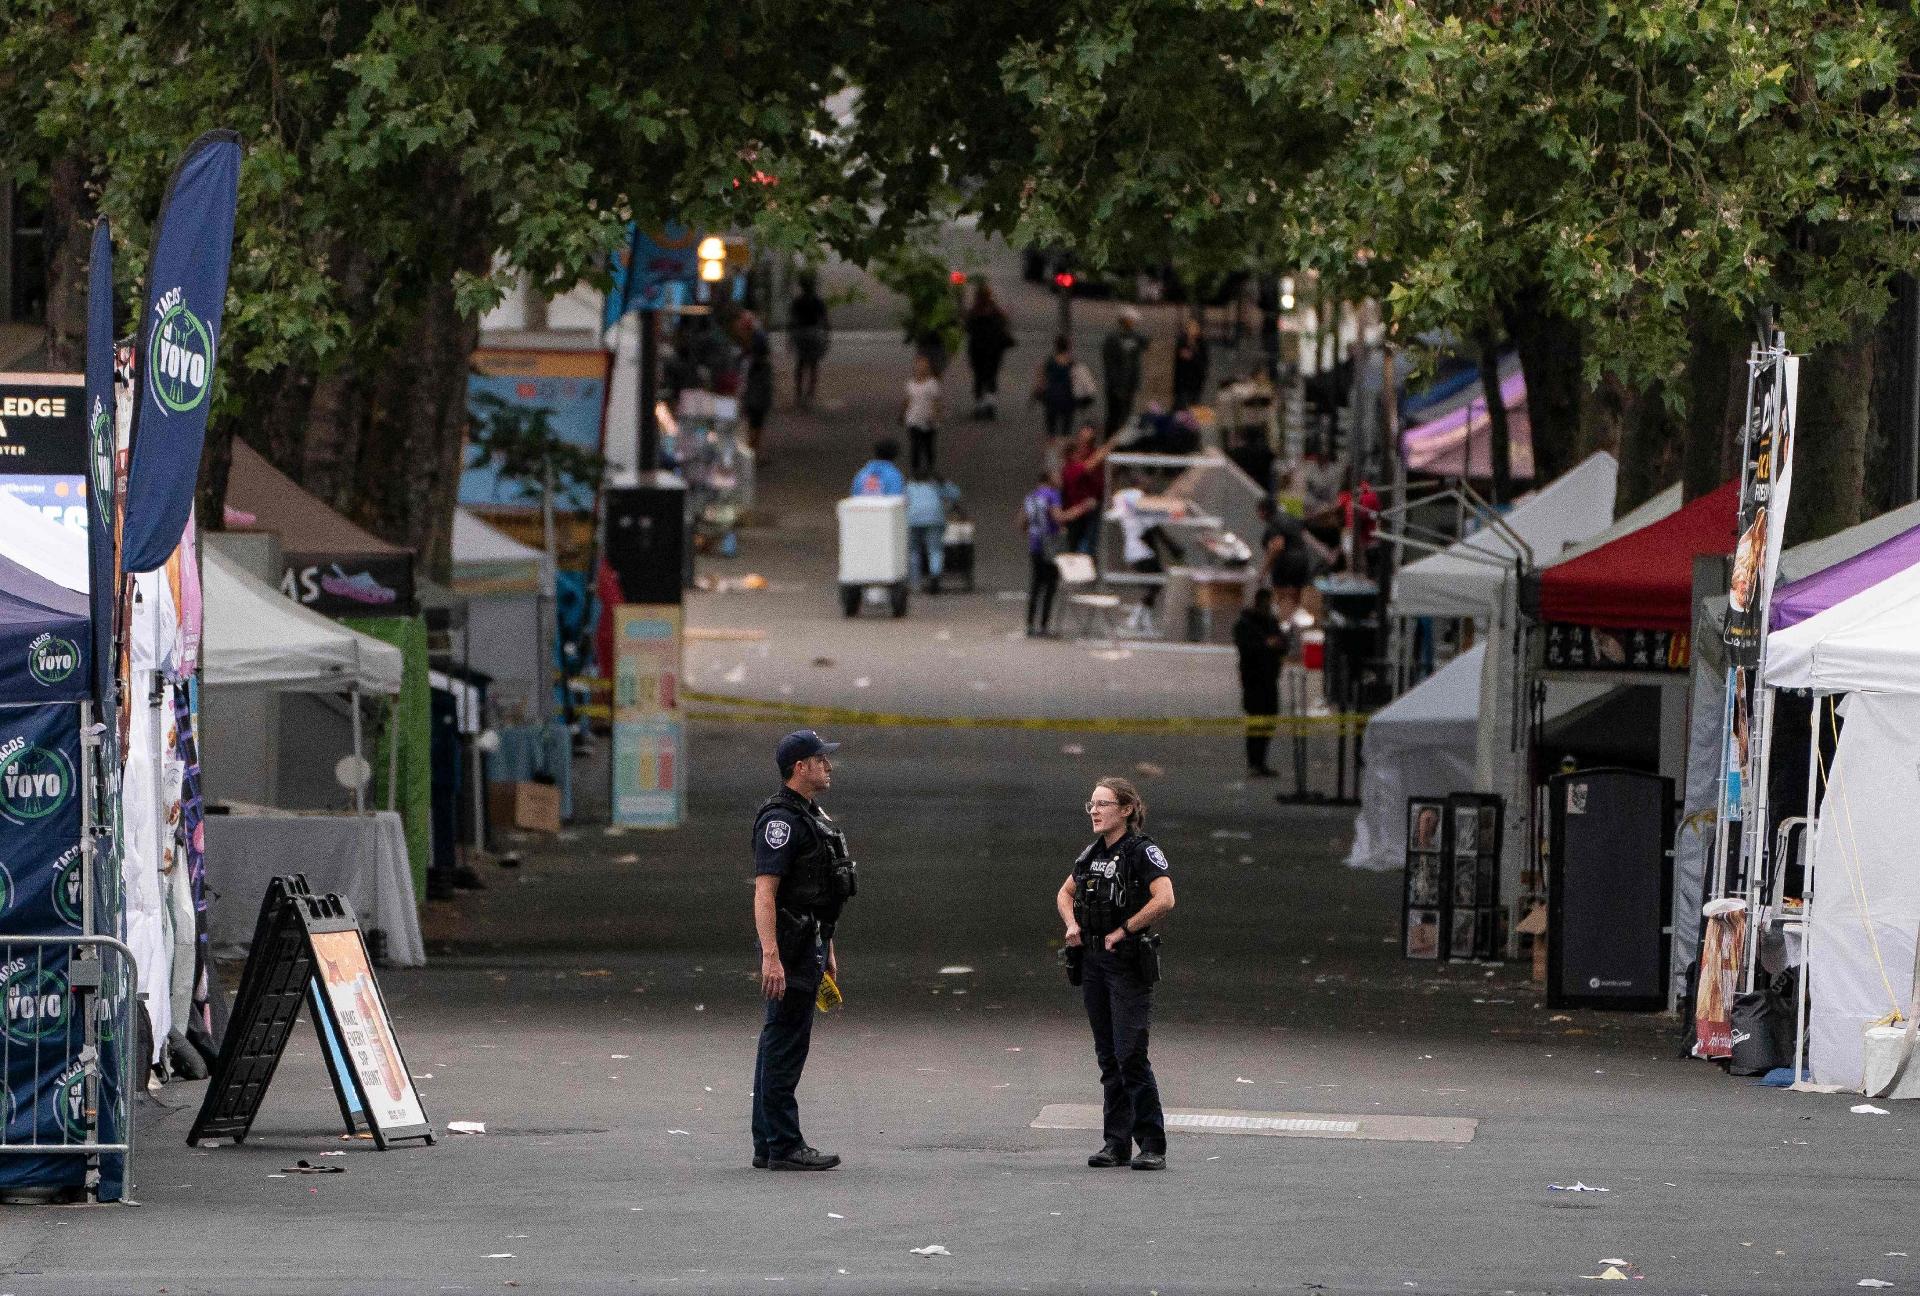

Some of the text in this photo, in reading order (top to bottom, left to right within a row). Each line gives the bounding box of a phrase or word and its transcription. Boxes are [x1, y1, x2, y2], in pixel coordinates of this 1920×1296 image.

[155, 286, 181, 320] TACO
[160, 338, 205, 388] YOYO
[0, 397, 66, 418] EDGE
[29, 632, 51, 650] TACOS
[39, 647, 47, 657] el
[38, 655, 72, 671] YOYO
[0, 736, 25, 764] ACOS
[7, 761, 19, 775] el
[4, 773, 60, 798] YOYO
[53, 845, 80, 872] TACO
[1090, 861, 1107, 872] POLICE
[0, 957, 26, 987] ACOS
[9, 983, 20, 997] el
[8, 994, 61, 1020] YOYO
[70, 1082, 82, 1096] el
